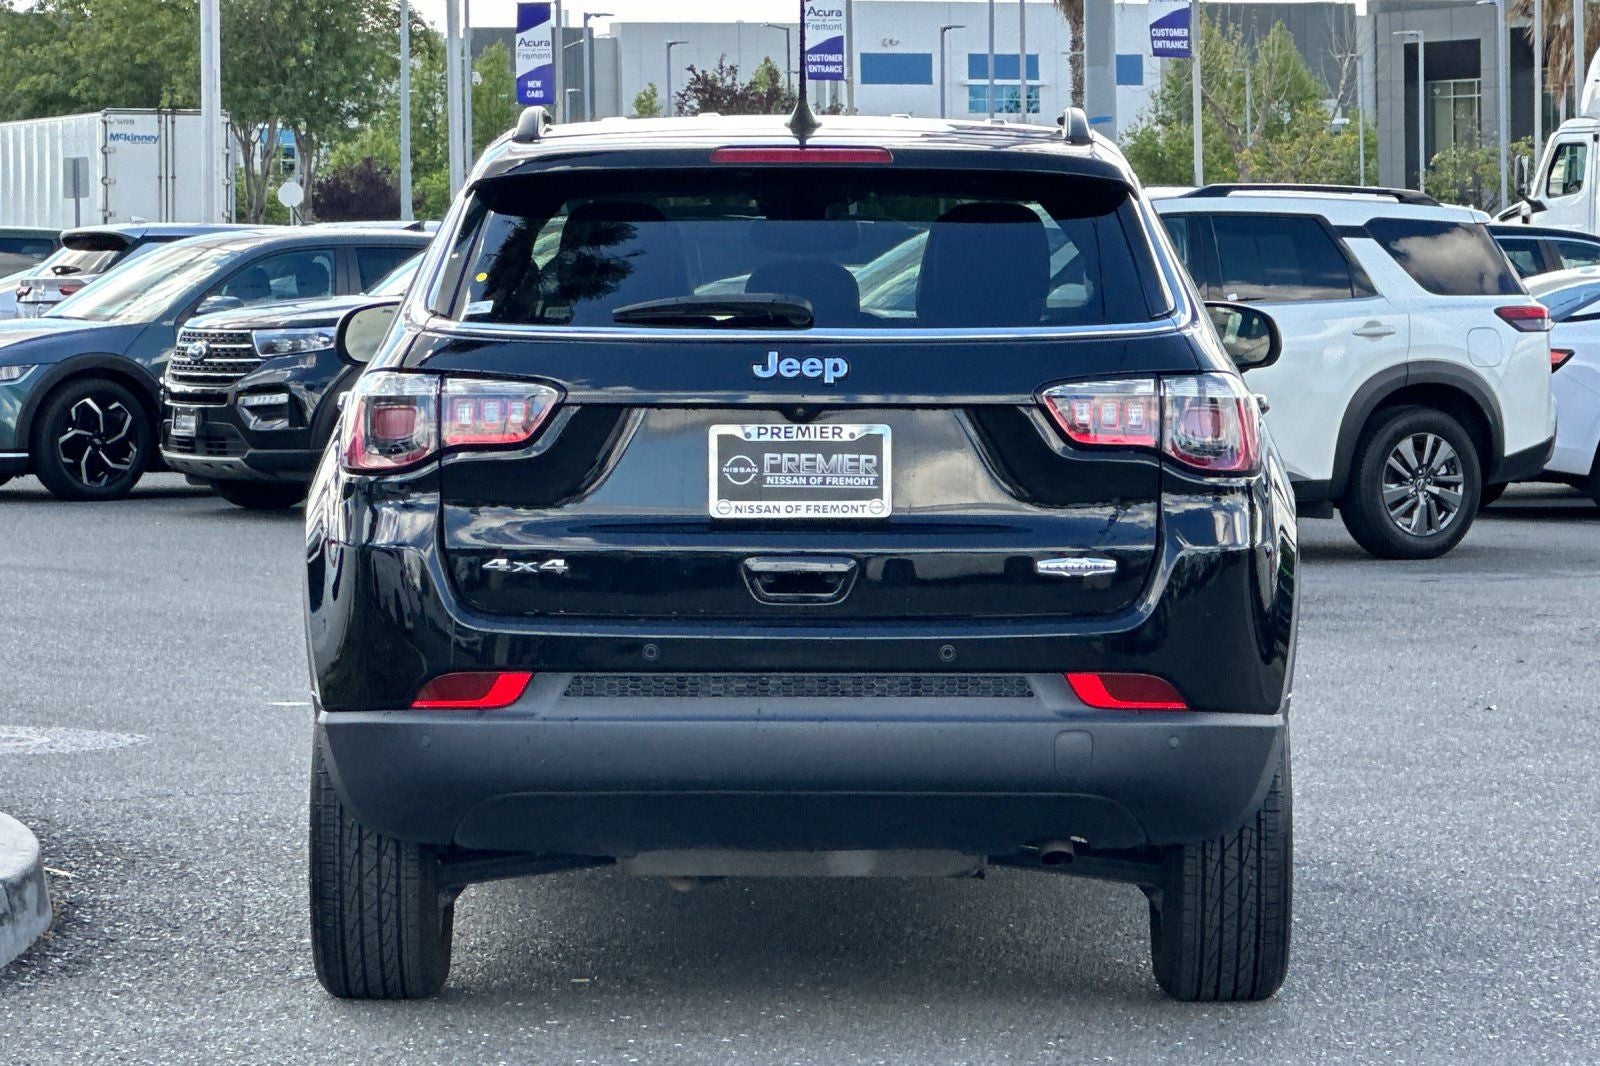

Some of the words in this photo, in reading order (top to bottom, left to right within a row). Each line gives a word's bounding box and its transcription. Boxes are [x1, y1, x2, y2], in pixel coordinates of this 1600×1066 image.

[807, 6, 843, 17] Acura
[806, 22, 843, 31] Fremont
[1151, 28, 1189, 37] CUSTOMER
[517, 37, 551, 48] Acura
[1153, 40, 1189, 49] ENTRANCE
[517, 52, 551, 60] Fremont
[807, 53, 843, 62] CUSTOMER
[808, 64, 843, 73] ENTRANCE
[527, 80, 542, 88] NEW
[526, 90, 545, 98] CARS
[753, 351, 848, 384] Jeep
[757, 426, 843, 439] PREMIER
[763, 452, 878, 476] PREMIER
[766, 476, 807, 485] NISSAN
[809, 476, 823, 485] OF
[826, 476, 875, 486] FREMONT
[734, 505, 782, 514] NISSAN
[785, 505, 801, 514] OF
[805, 504, 867, 514] FREMONT
[482, 558, 569, 573] 4x4
